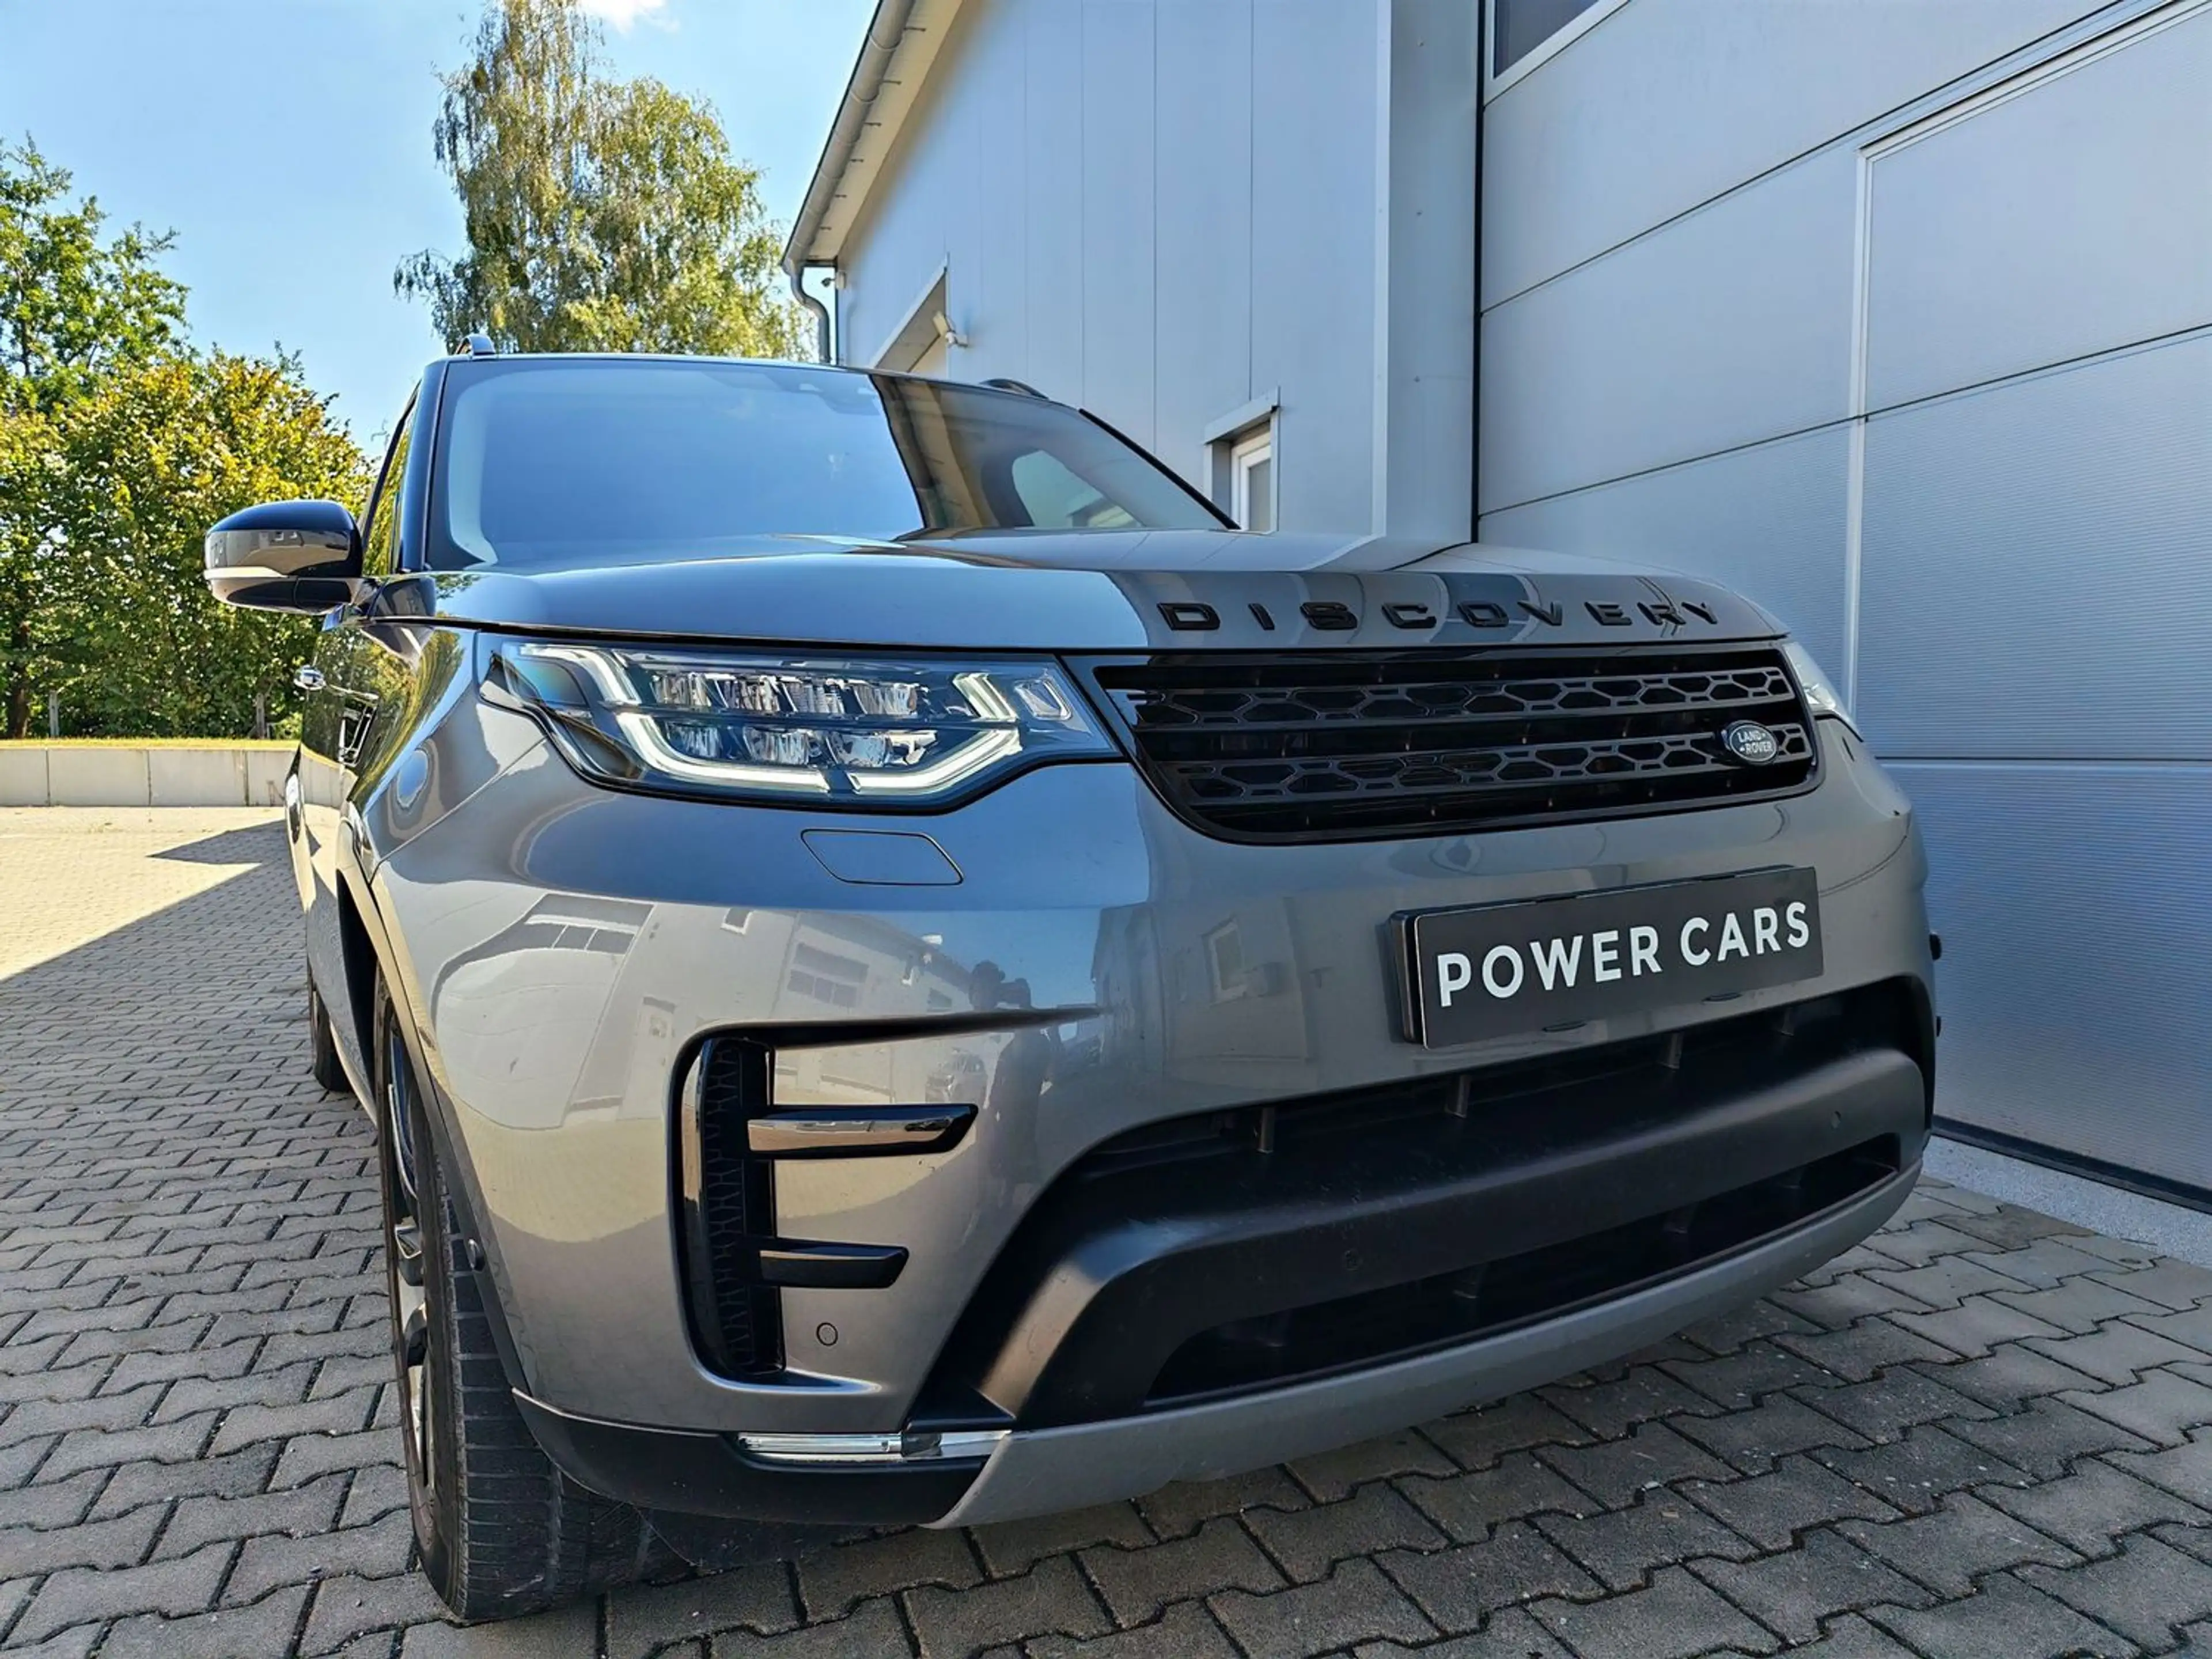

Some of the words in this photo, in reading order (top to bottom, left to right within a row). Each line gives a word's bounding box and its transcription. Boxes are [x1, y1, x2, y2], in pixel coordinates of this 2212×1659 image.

[1157, 600, 1719, 631] DISCOVERY
[1737, 730, 1762, 743] LAND
[1745, 741, 1773, 755] ROVER
[1437, 925, 1663, 1007] POWER
[1680, 902, 1810, 967] CARS
